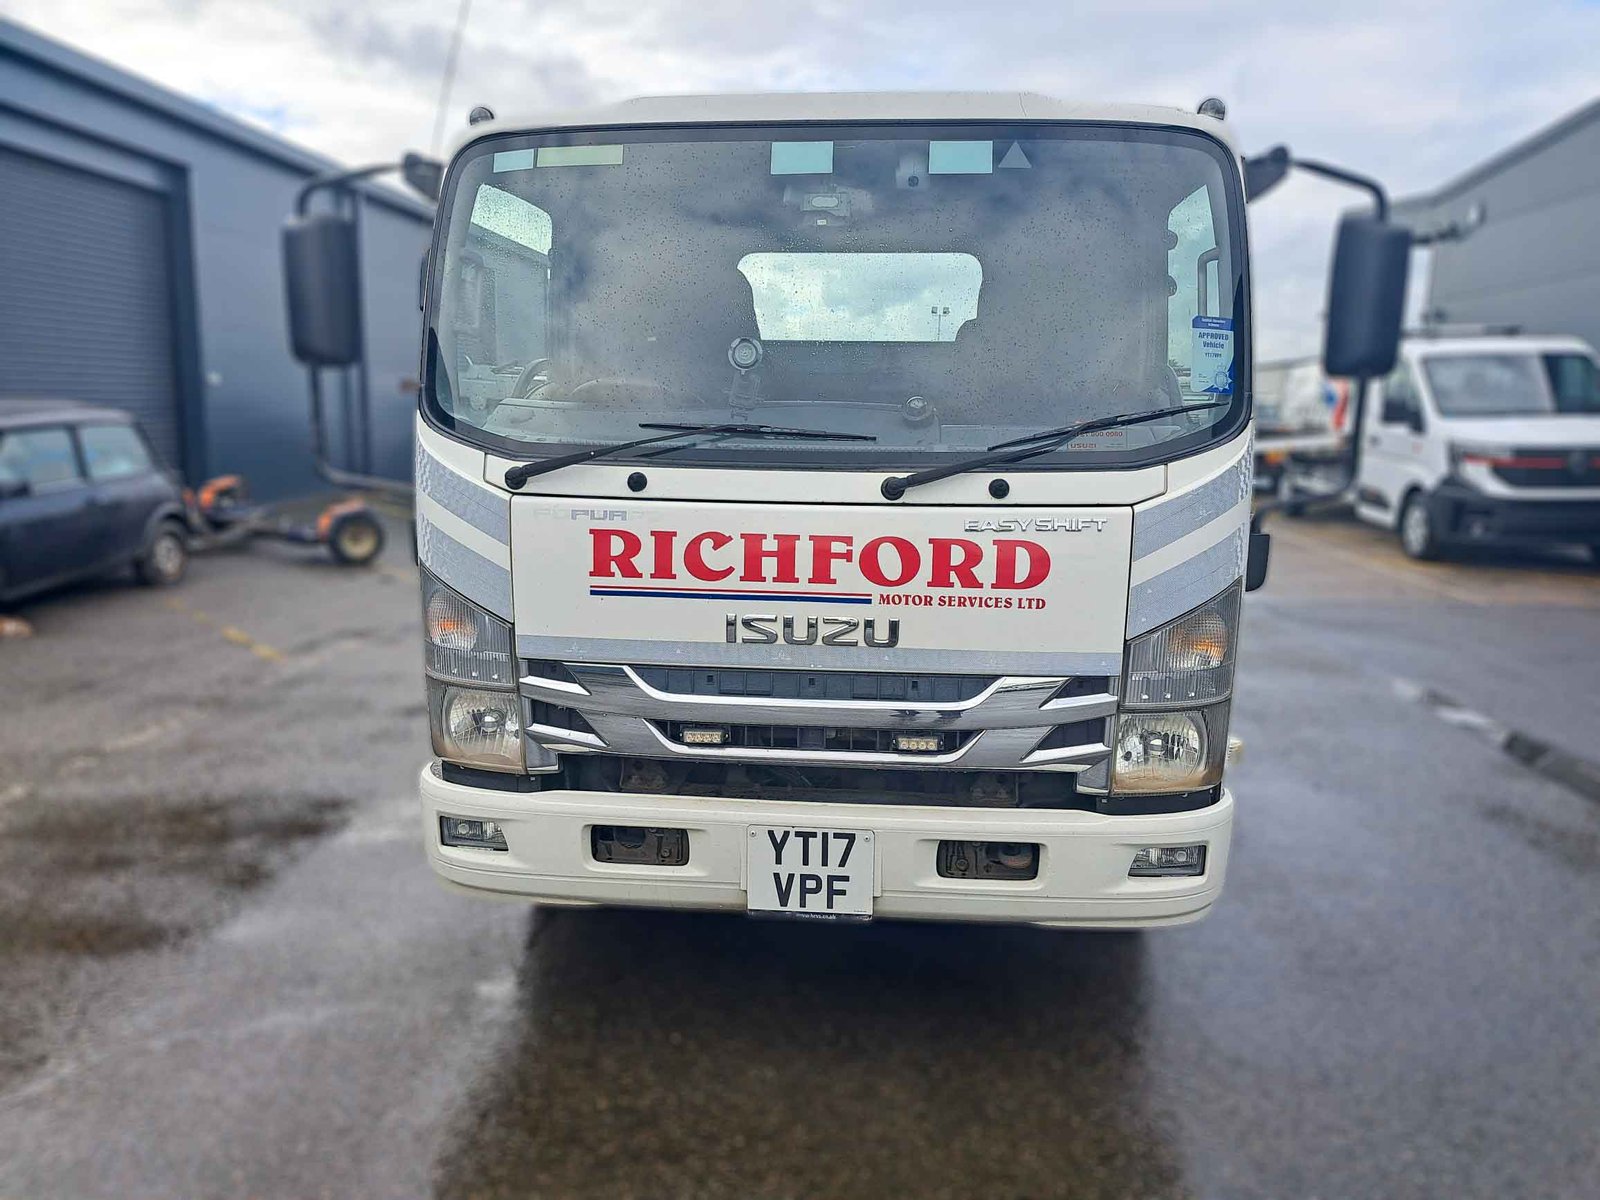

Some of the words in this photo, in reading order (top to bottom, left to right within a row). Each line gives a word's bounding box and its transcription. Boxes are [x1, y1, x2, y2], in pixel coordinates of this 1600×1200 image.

[1198, 331, 1229, 341] APPROVED
[1202, 341, 1225, 350] Vehicle
[589, 528, 1051, 590] RICHFORD
[879, 594, 934, 607] MOTOR
[938, 595, 1013, 609] SERVICES
[1017, 598, 1047, 610] LTD
[725, 613, 900, 649] ISUZU
[767, 829, 857, 867] YT17
[773, 872, 850, 909] VPF
